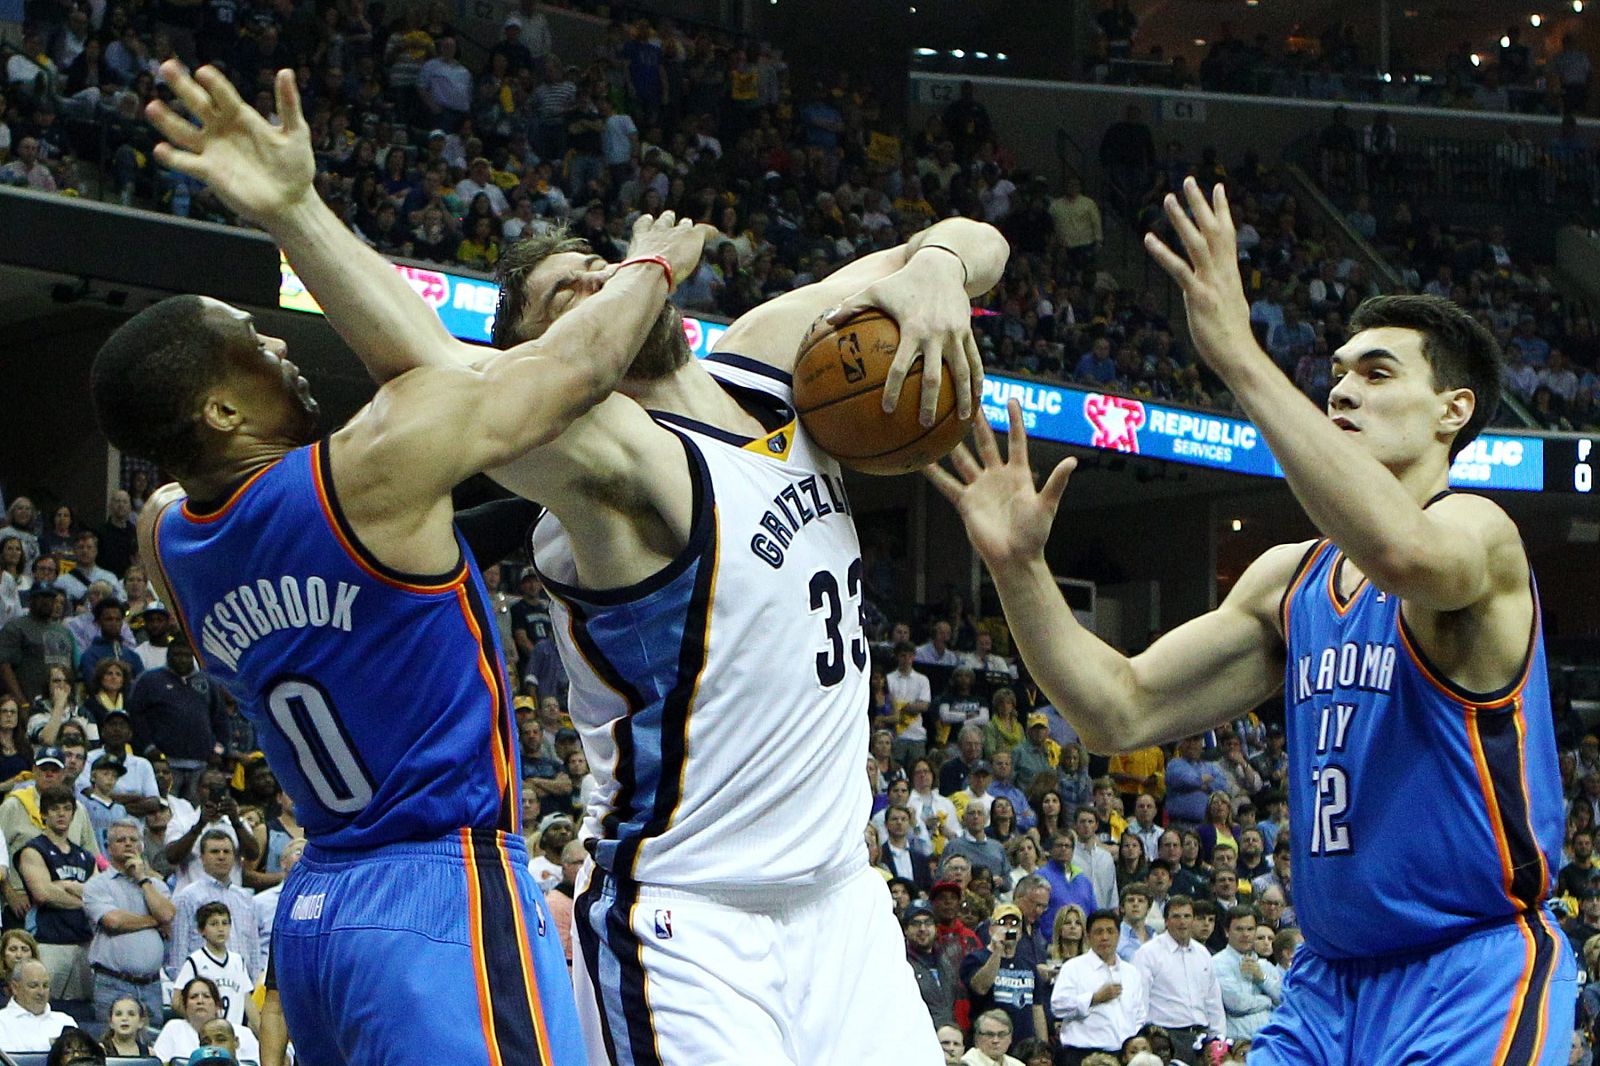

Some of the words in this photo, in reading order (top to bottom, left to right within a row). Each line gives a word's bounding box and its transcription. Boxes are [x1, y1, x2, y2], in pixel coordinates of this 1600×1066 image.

[1148, 409, 1257, 450] REPUBLIC
[1172, 438, 1233, 463] SERVICES
[202, 575, 361, 673] WESTBROOK
[808, 556, 868, 688] 33
[266, 678, 376, 815] 0
[1310, 763, 1351, 856] 12
